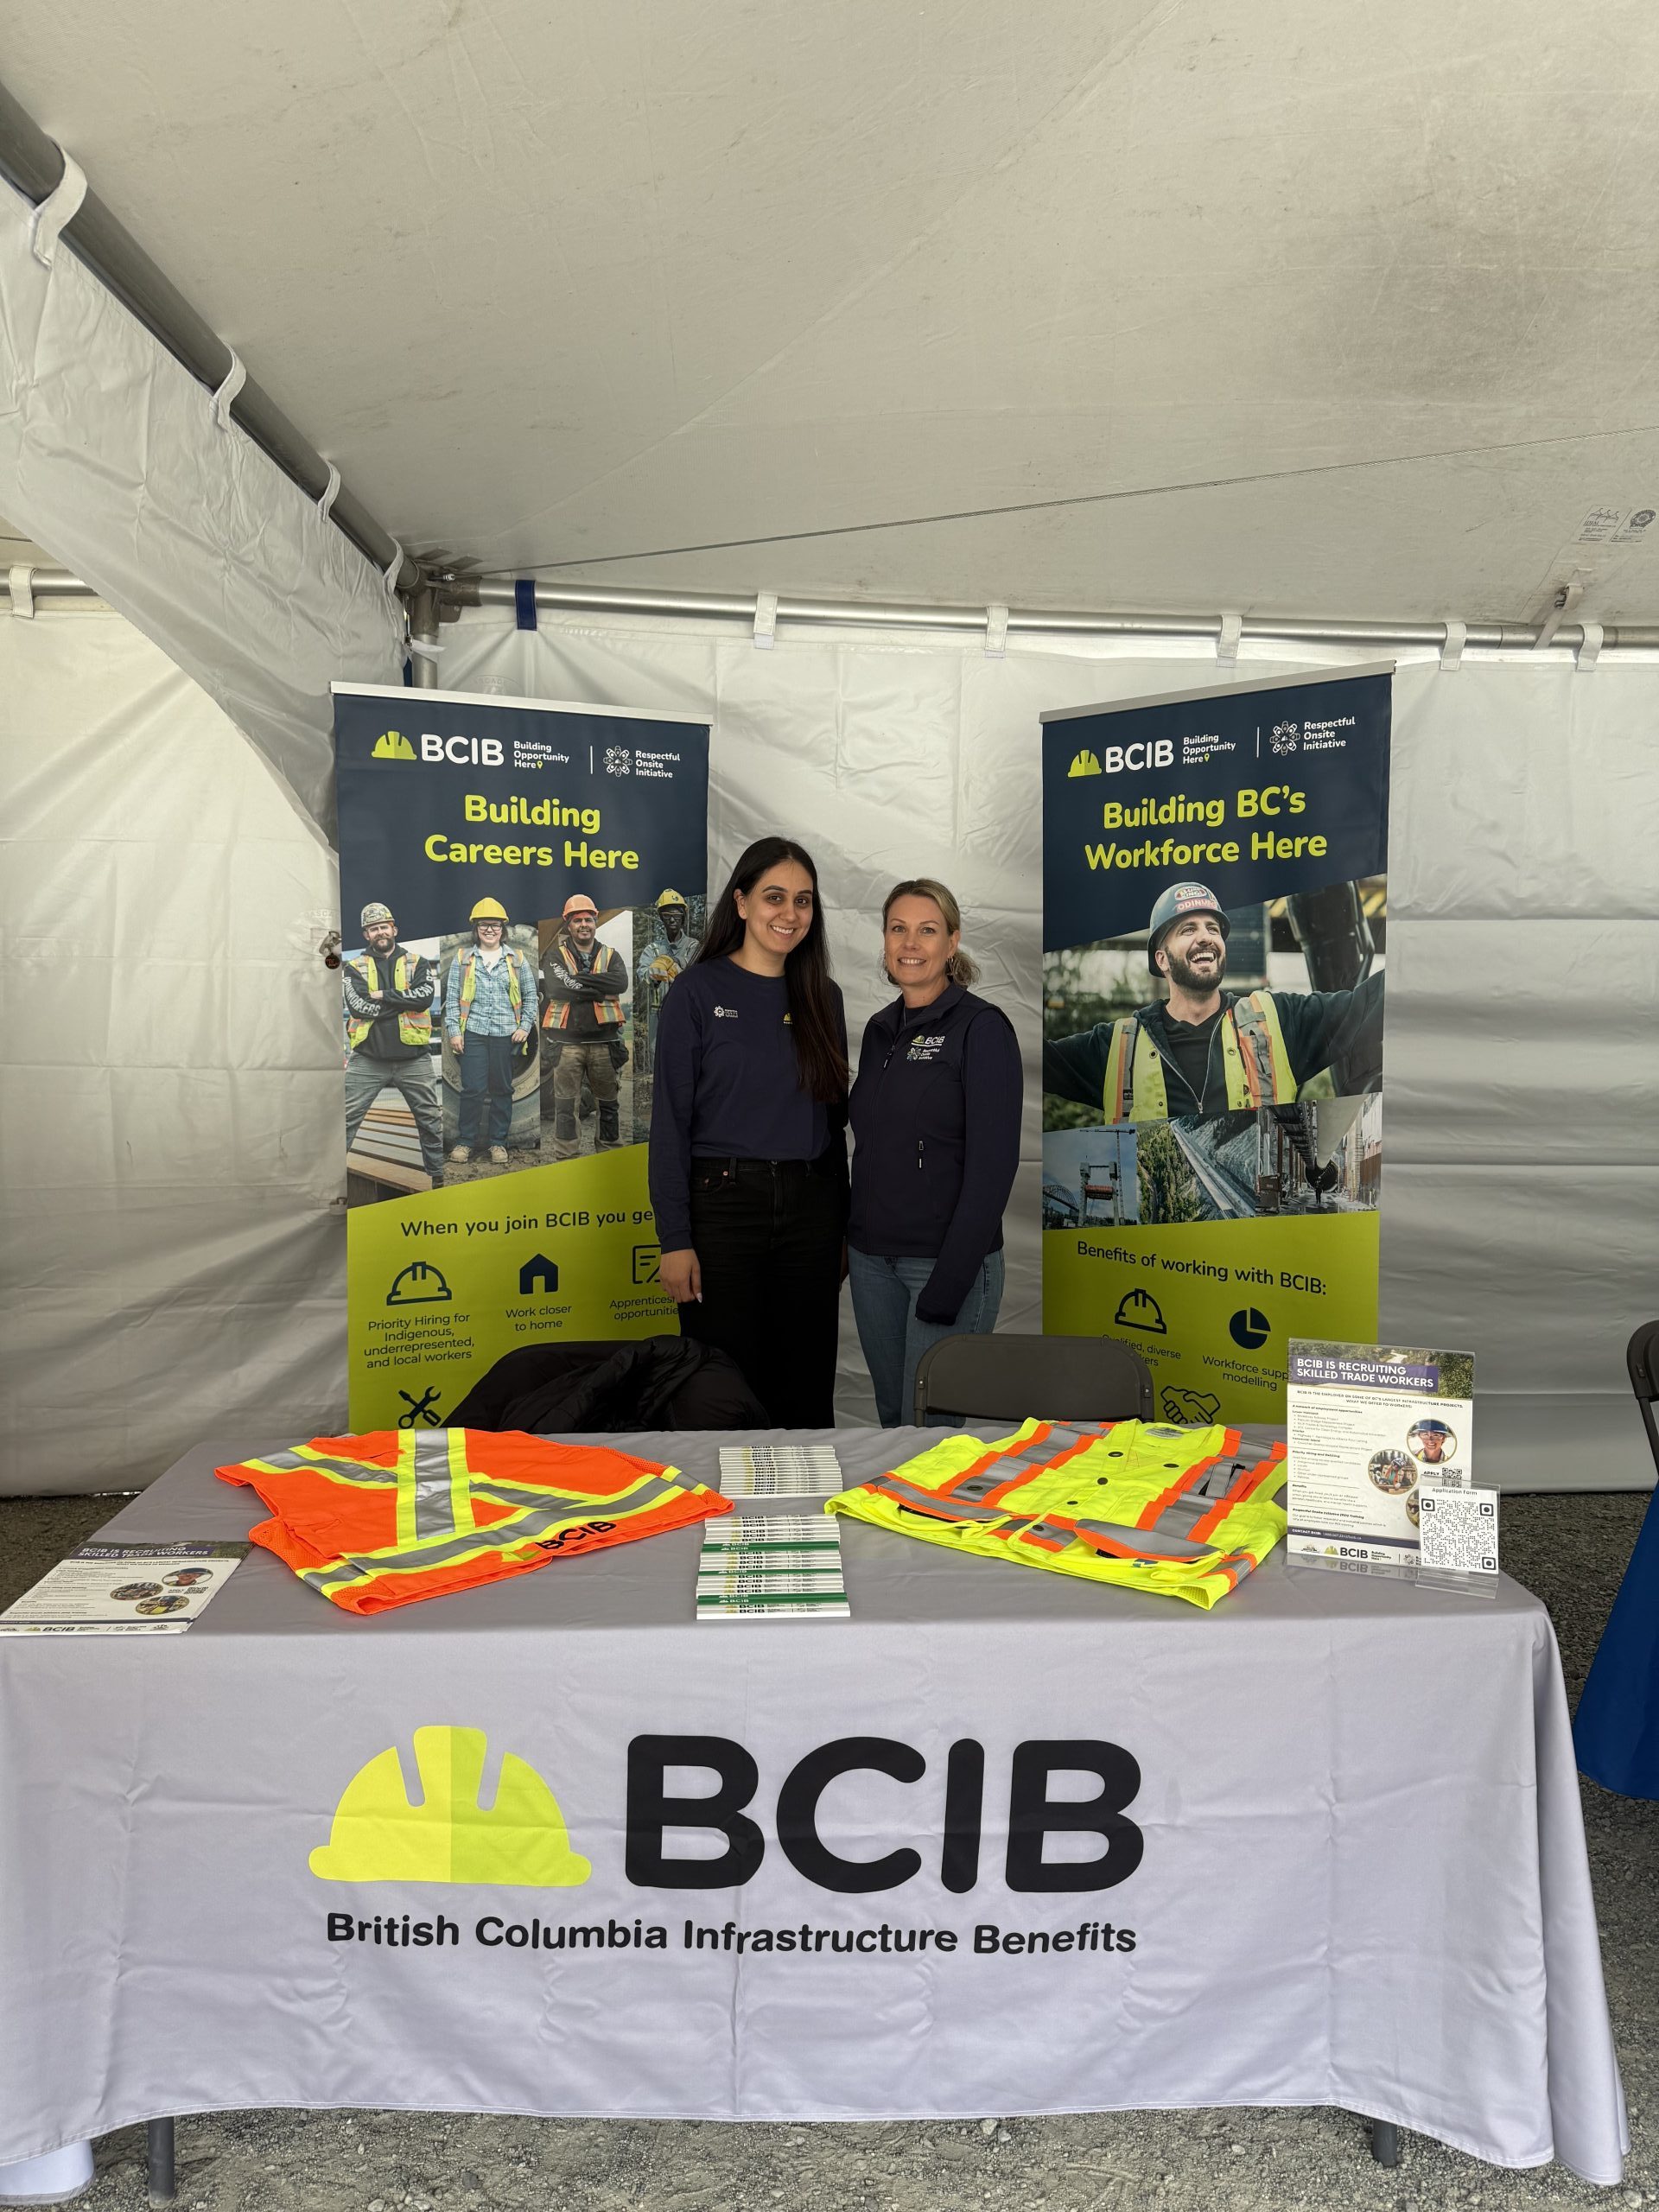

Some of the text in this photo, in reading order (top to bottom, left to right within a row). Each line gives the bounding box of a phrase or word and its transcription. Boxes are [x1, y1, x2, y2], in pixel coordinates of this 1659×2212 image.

[1304, 716, 1356, 730] Respectful
[1183, 734, 1219, 745] Building
[1304, 729, 1336, 740] Onsite
[420, 734, 505, 767] BCIB
[513, 741, 551, 753] Building
[1182, 741, 1236, 755] Opportunity
[1303, 738, 1346, 751] Initiative
[513, 751, 569, 764] Opportunity
[635, 750, 681, 762] Respectful
[635, 759, 664, 769] Onsite
[1104, 739, 1174, 773] BCIB
[1182, 754, 1204, 765] Here
[513, 760, 536, 769] Here
[635, 767, 673, 779] Initiative
[464, 794, 601, 834] Building
[1103, 785, 1306, 830] Building BC’s
[424, 834, 639, 870] Careers Here
[1084, 831, 1327, 871] Workforce Here
[925, 1036, 945, 1045] BCIB
[401, 1210, 653, 1237] When you join BCIB you ge
[1077, 1241, 1326, 1295] Benefits of working with BCIB:
[505, 1304, 572, 1319] Work closer
[614, 1306, 679, 1321] opportunitie
[368, 1312, 470, 1332] Priority Hiring for
[515, 1318, 563, 1332] to home
[385, 1326, 455, 1342] Indigenous,
[364, 1337, 475, 1357] underrepresented,
[1147, 1344, 1181, 1359] diverse
[366, 1349, 473, 1369] and local workers
[1202, 1355, 1259, 1375] Workforce
[1297, 1358, 1407, 1376] BCIB IS RECRUITING
[1223, 1370, 1278, 1392] modelling
[1297, 1368, 1433, 1388] SKILLED TRADE WORKERS
[535, 1521, 617, 1549] BCIB
[1339, 1547, 1369, 1559] BCIB
[625, 1733, 1145, 1894] BCIB
[326, 1912, 1136, 1955] British Columbia Infrastructure Benefits
